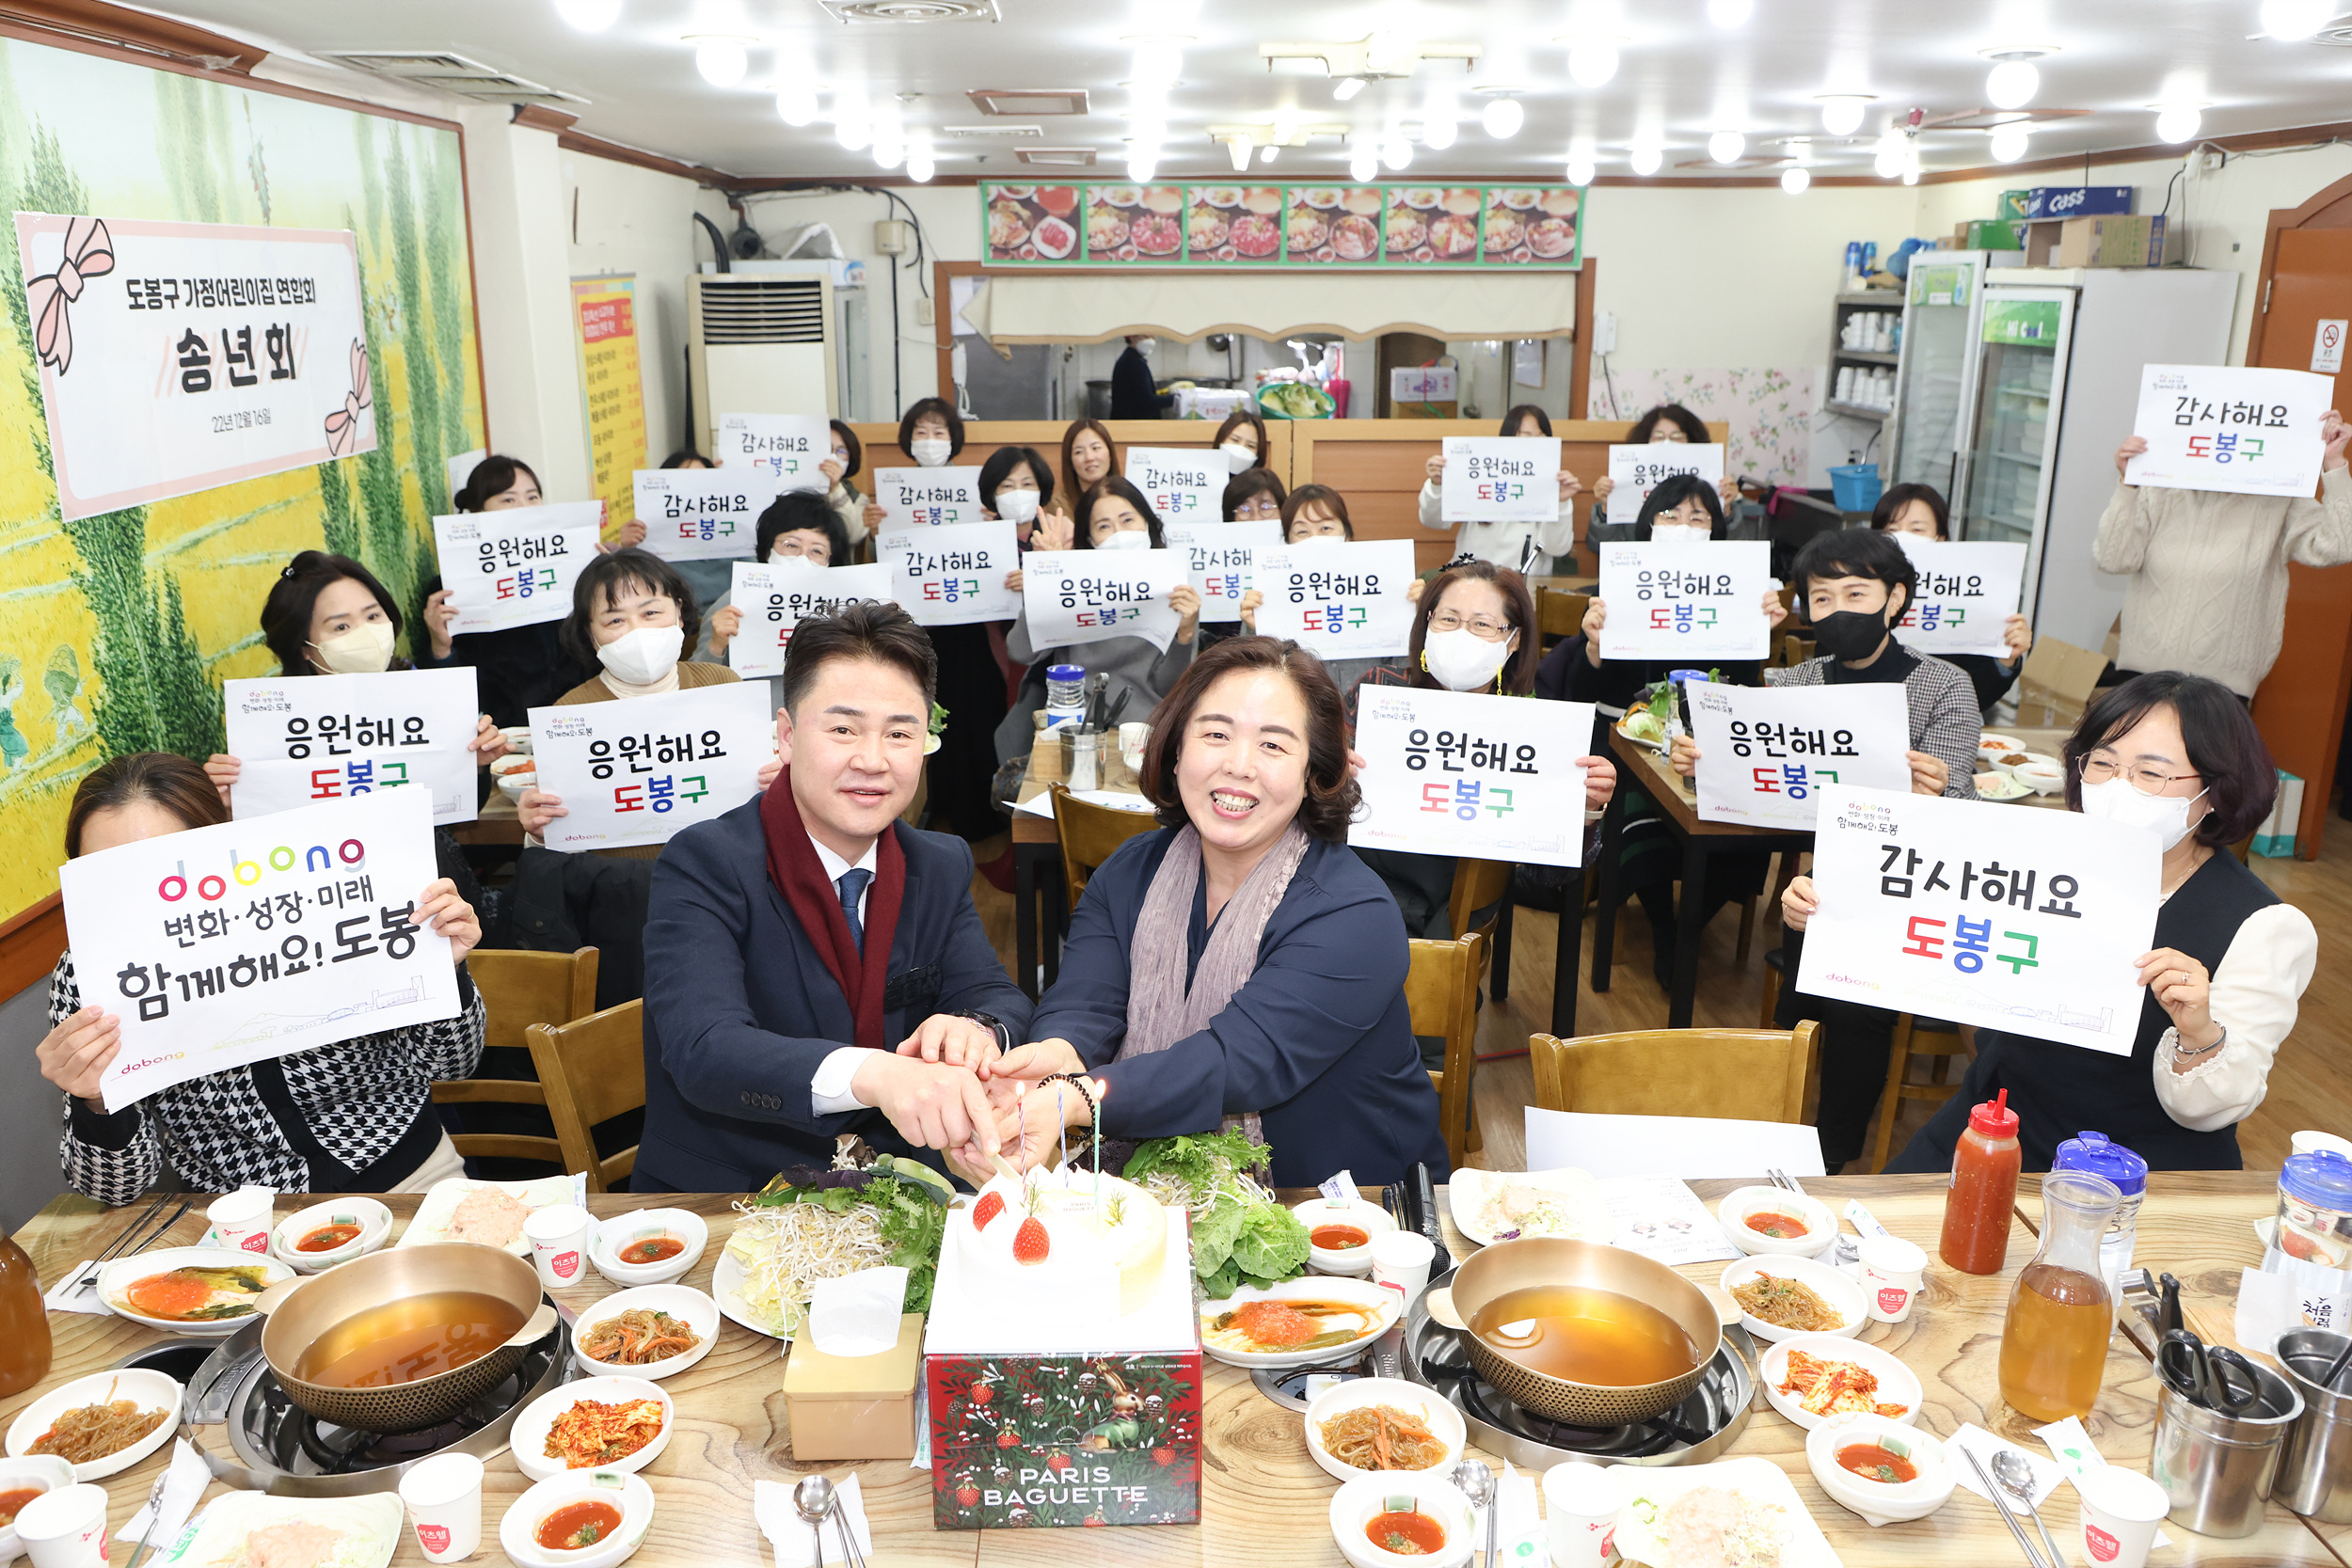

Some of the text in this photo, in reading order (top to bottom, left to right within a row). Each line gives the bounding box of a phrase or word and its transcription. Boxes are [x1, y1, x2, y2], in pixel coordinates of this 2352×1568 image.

[2049, 189, 2086, 213] Cass
[126, 277, 316, 309] 도봉구 가정어린이집 연합회
[2007, 321, 2043, 340] Hi Cool
[212, 407, 272, 433] 22년 12월 16일
[2175, 397, 2289, 427] 감사해요
[741, 433, 810, 453] 감사해요
[2186, 433, 2265, 463] 도봉구
[1146, 468, 1208, 489] 감사해요
[1468, 457, 1535, 479] 응원해요
[899, 487, 969, 505] 감사해요
[1156, 492, 1198, 513] 도봉구
[1477, 482, 1524, 502] 도봉구
[664, 495, 749, 518] 감사해요
[913, 507, 958, 526] 도봉구
[679, 518, 736, 541] 도봉구
[479, 534, 568, 574] 응원해요
[906, 551, 993, 577] 감사해요
[1189, 547, 1252, 571] 감사해
[497, 568, 557, 599] 도봉구
[924, 578, 979, 603] 도봉구
[1059, 578, 1154, 608] 응원해요
[1205, 574, 1252, 599] 도봉
[1288, 572, 1381, 603] 응원해요
[1636, 570, 1734, 601] 응원해요
[1915, 571, 1984, 599] 원해요
[1076, 608, 1140, 627] 도봉구
[1303, 605, 1367, 633] 도봉구
[1650, 604, 1718, 633] 도봉구
[285, 714, 429, 759] 응원해요
[1730, 721, 1859, 757] 응원해요
[588, 730, 726, 779] 응원해요
[1406, 729, 1538, 774] 응원해요
[311, 760, 409, 799] 도봉구
[614, 775, 708, 813] 도봉구
[1420, 779, 1514, 821] 도봉구
[1848, 801, 1891, 814] dobong
[564, 832, 606, 842] dobong
[1878, 822, 1899, 836] 도봉
[159, 838, 366, 901] dobong
[1880, 845, 2081, 918] 감사해요
[332, 900, 421, 963] 도봉
[1902, 914, 2039, 974] 도봉구
[1826, 973, 1880, 990] dobong
[120, 1051, 185, 1075] dobong
[244, 1235, 266, 1249] 이츠웰
[553, 1255, 577, 1267] 이츠웰
[1880, 1292, 1906, 1302] 이츠웰
[2302, 1297, 2332, 1317] 처음
[1019, 1466, 1110, 1486] PARIS
[983, 1486, 1148, 1506] BAGUETTE
[419, 1529, 447, 1540] 이츠웰
[2087, 1529, 2117, 1551] 이츠웰
